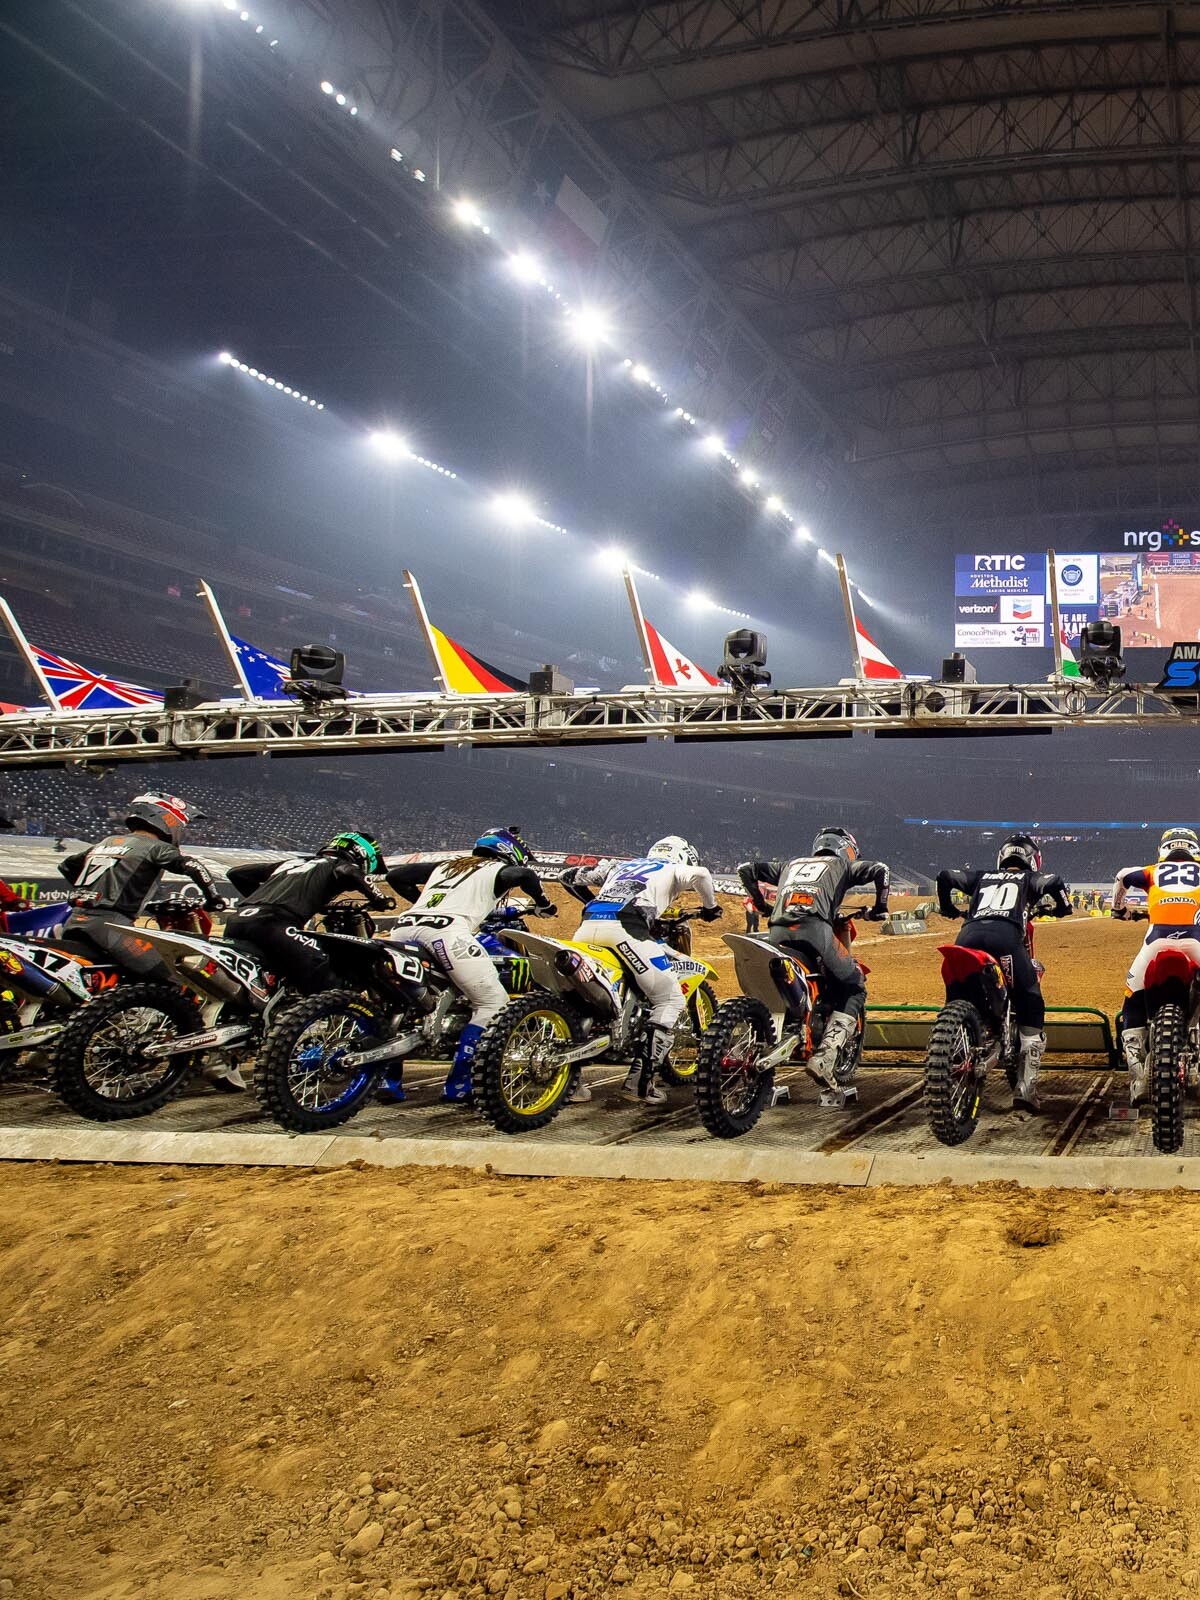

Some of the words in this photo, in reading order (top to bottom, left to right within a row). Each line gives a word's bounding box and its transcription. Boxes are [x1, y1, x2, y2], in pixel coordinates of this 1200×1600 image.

[1123, 531, 1162, 551] nrg
[974, 554, 1026, 571] RTIC
[970, 575, 1030, 589] Methodist
[959, 603, 994, 614] verizon
[1071, 613, 1088, 623] ARE
[957, 629, 1008, 640] ConocoPhillips
[74, 856, 121, 887] 17
[1158, 863, 1200, 888] 23
[976, 882, 1019, 911] 10
[1160, 896, 1197, 905] HONDA
[28, 949, 72, 974] 17
[619, 942, 647, 974] SUZUKI
